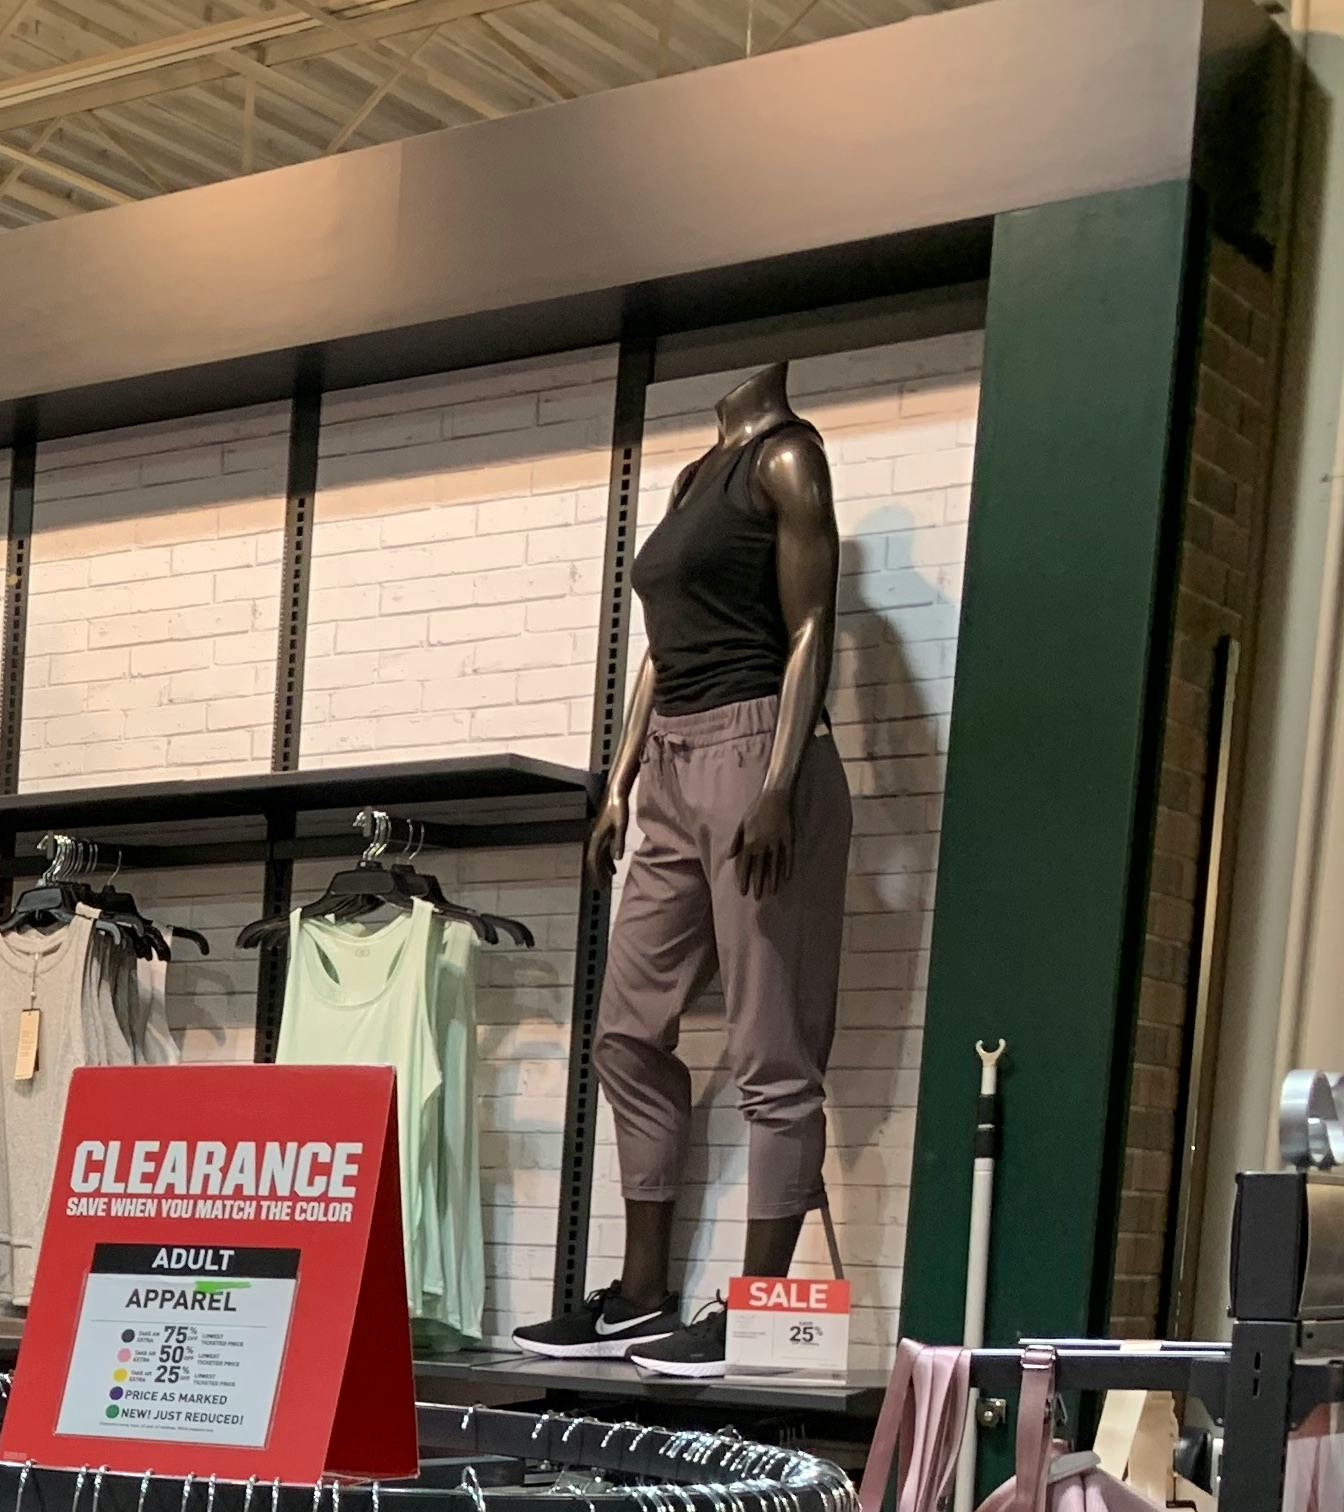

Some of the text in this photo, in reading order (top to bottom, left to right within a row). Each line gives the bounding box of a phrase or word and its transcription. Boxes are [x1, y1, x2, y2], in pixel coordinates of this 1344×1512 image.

[69, 1140, 364, 1198] CLEARANCE
[66, 1197, 353, 1223] SAVE WHEN YOU MATCH THE COLOR
[151, 1247, 235, 1271] ADULT
[125, 1288, 237, 1312] APPAREL
[749, 1281, 829, 1309] SALE
[124, 1389, 228, 1405] PRICE AS MARKED
[121, 1408, 245, 1426] NEW! JUST REDUCED!
